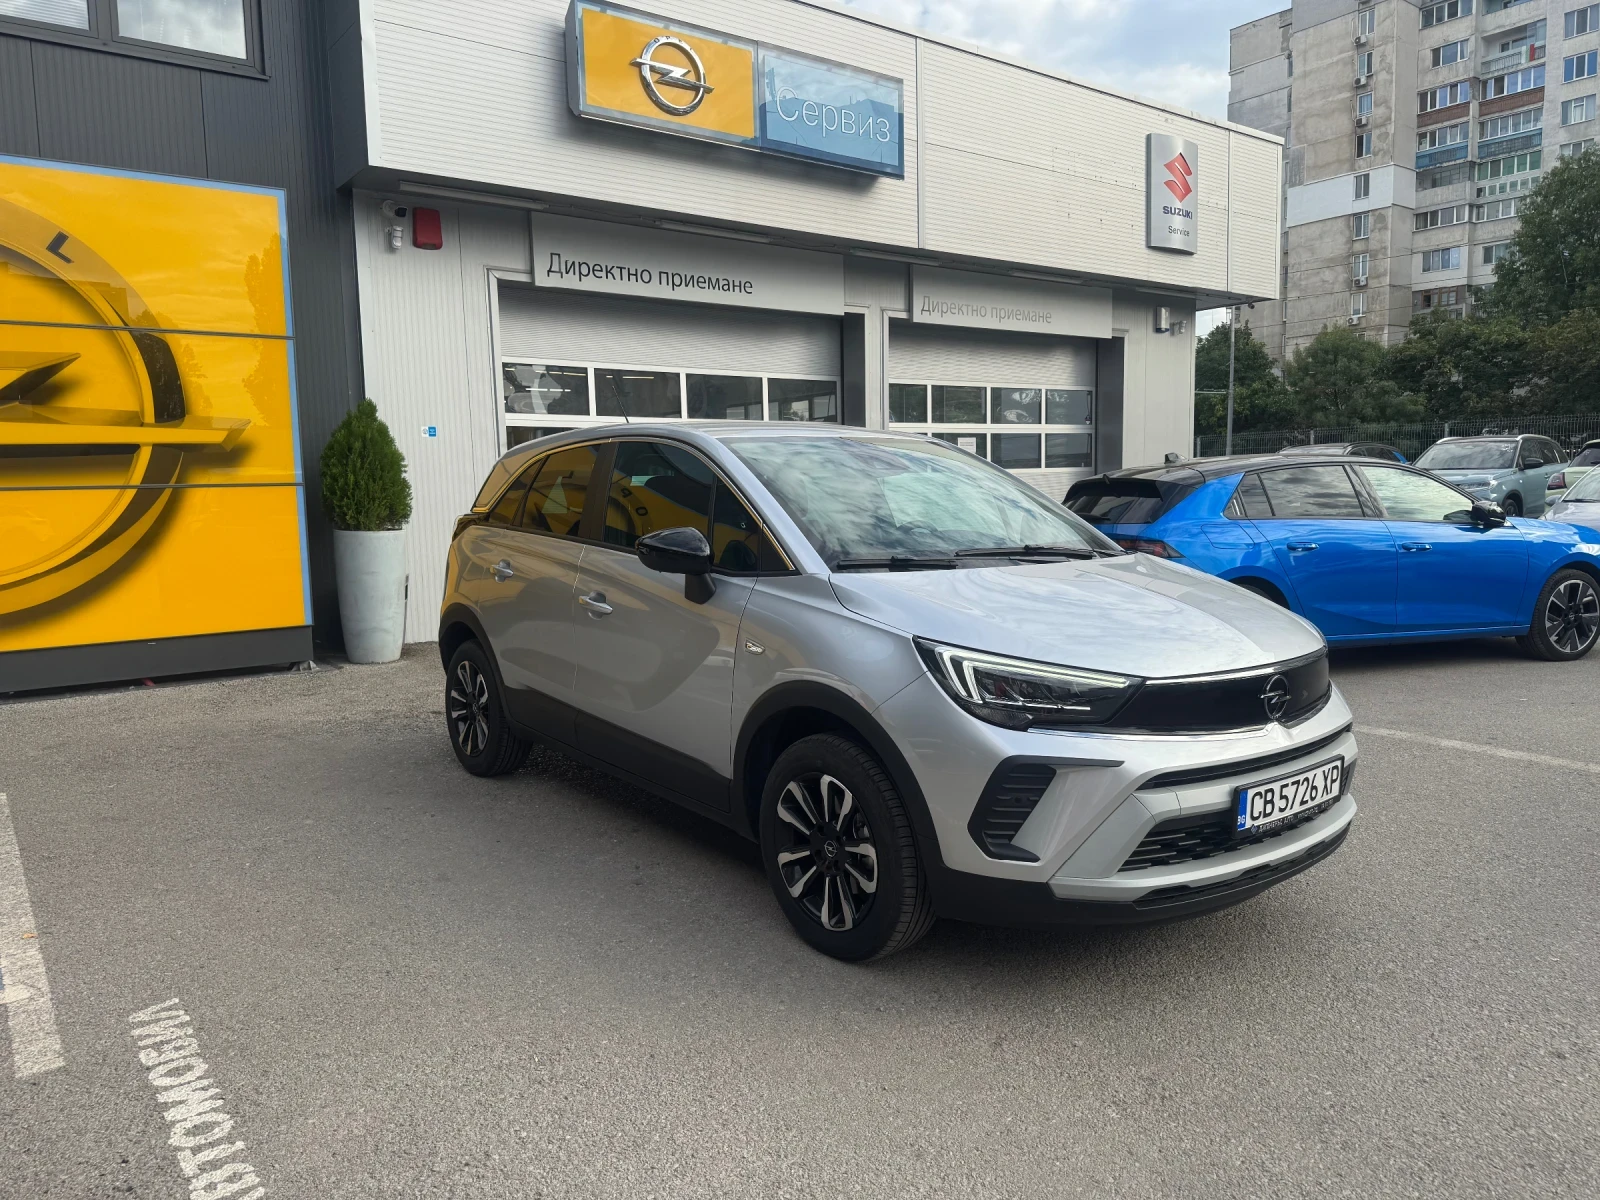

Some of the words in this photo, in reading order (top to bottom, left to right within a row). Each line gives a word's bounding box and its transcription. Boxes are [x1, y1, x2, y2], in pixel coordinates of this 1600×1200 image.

[776, 86, 890, 142] Сервиз
[1162, 205, 1193, 220] SUZUKI
[1168, 225, 1190, 237] Service
[547, 252, 653, 285] Директно
[658, 270, 754, 295] приемане
[920, 295, 988, 319] Директно
[990, 306, 1053, 324] приемане
[1278, 773, 1318, 812] 5726
[128, 997, 268, 1200] ВТОМОБИЛ
